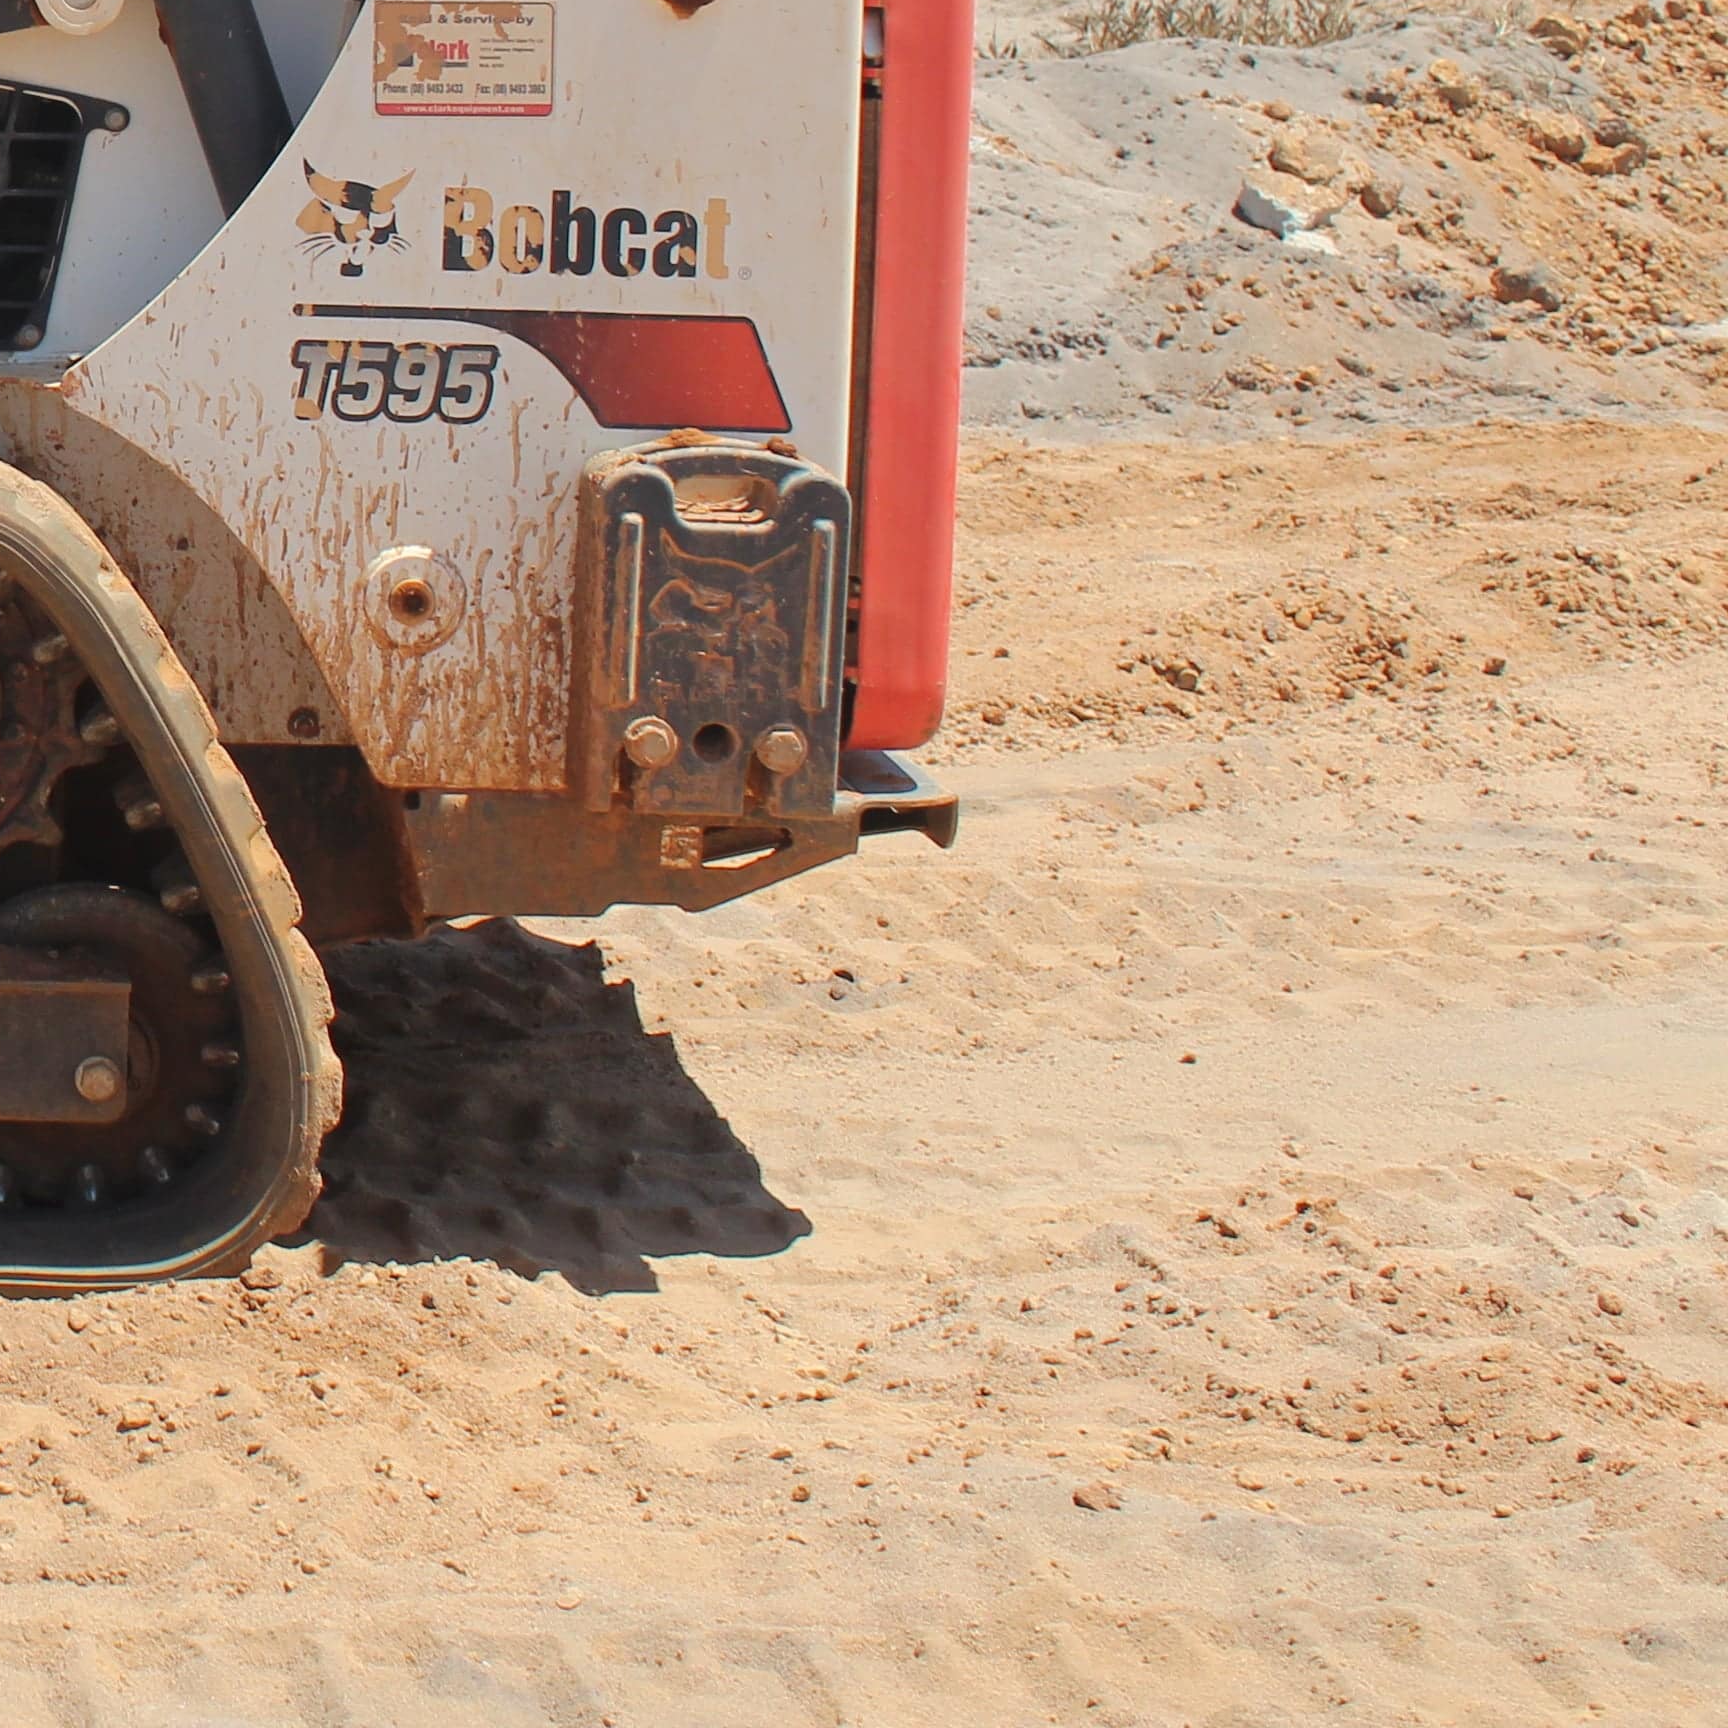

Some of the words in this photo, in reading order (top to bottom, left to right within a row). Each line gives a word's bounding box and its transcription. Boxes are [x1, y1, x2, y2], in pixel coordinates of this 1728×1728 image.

[438, 14, 448, 24] &
[516, 14, 534, 26] by
[426, 39, 469, 60] lark
[442, 186, 731, 280] Bobcat
[290, 339, 501, 424] T595
